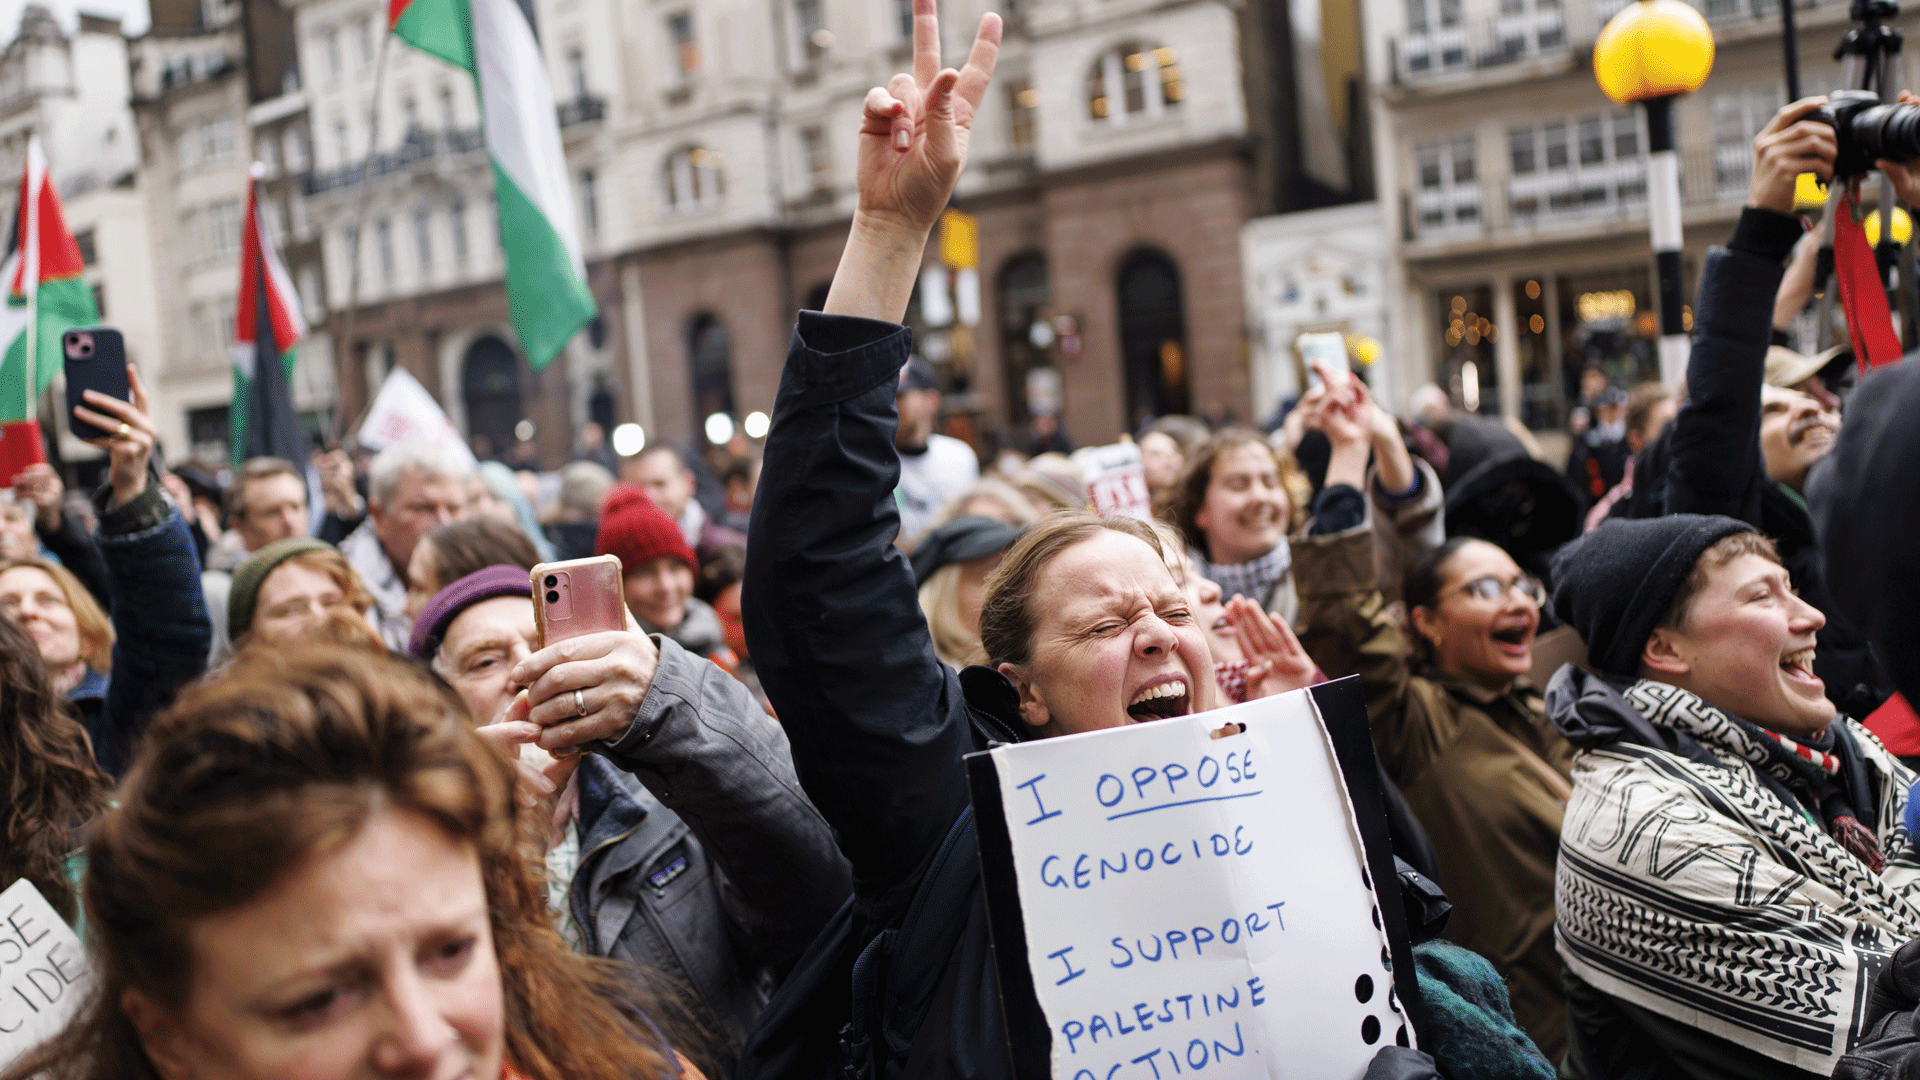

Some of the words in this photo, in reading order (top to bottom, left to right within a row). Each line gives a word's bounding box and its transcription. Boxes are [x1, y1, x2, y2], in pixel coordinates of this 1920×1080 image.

[1015, 773, 1064, 827] I
[1095, 748, 1257, 809] OPPOSE
[1039, 824, 1254, 890] GENOCIDE
[1046, 945, 1087, 988] I
[1109, 900, 1286, 970] SUPPORT
[1060, 975, 1266, 1055] PALESTINE
